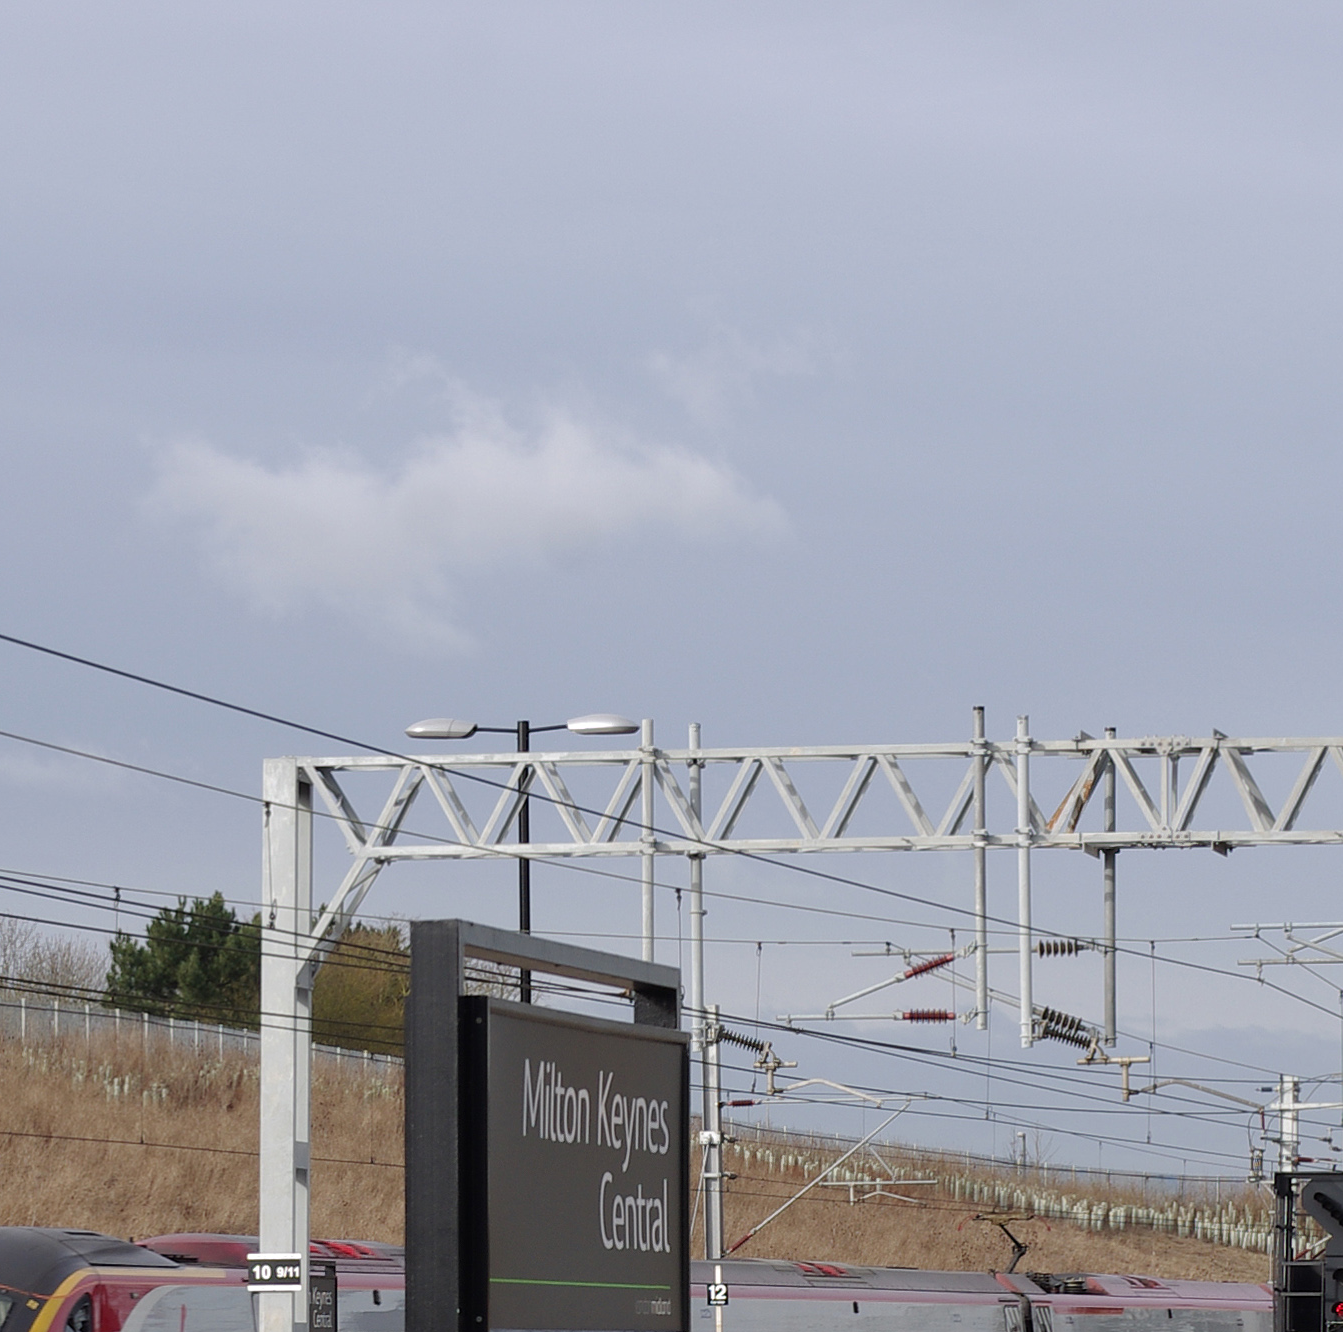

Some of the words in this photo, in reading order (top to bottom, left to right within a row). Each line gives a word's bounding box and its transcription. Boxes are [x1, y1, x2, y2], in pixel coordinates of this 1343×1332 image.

[522, 1058, 590, 1145] Milton
[596, 1070, 669, 1173] Keynes
[598, 1171, 671, 1253] Central
[252, 1264, 272, 1280] 10
[276, 1266, 300, 1278] 9/11
[708, 1284, 727, 1300] 12
